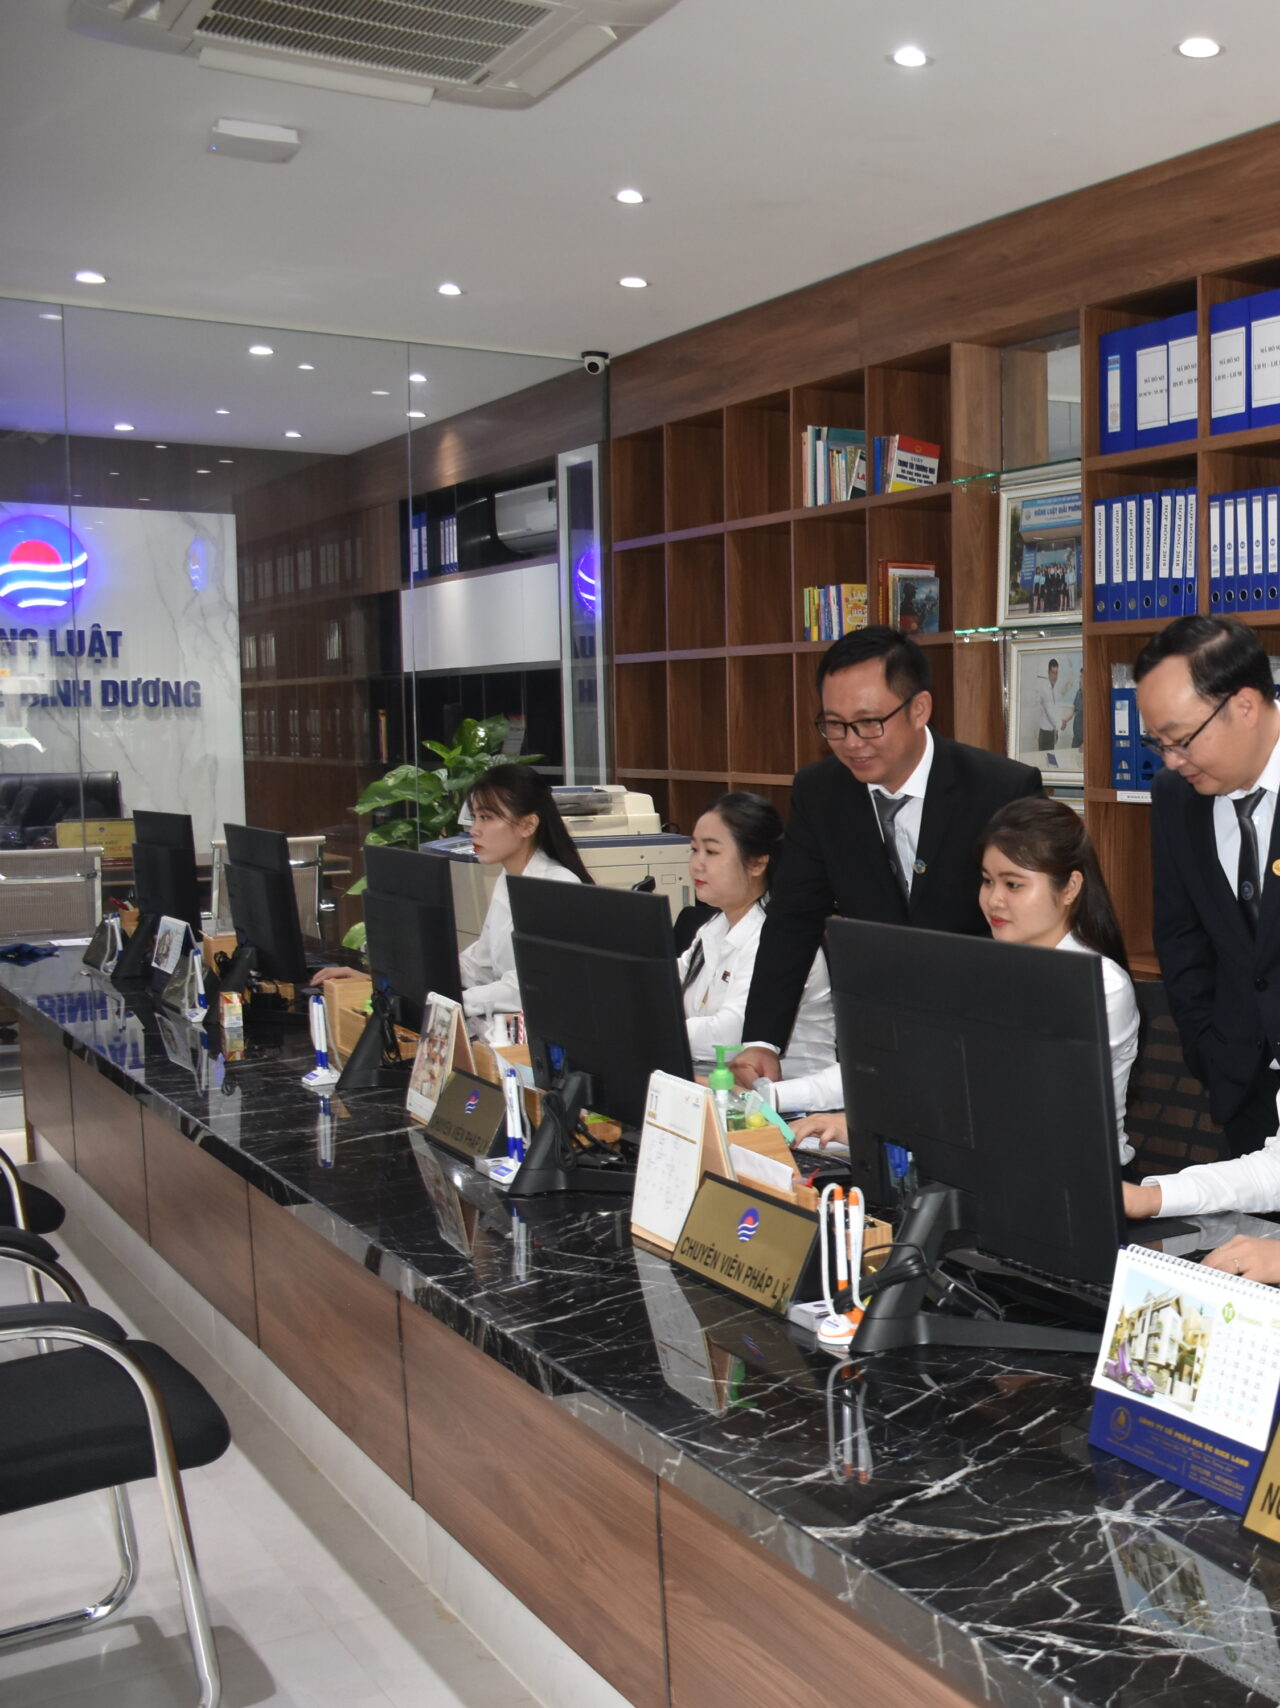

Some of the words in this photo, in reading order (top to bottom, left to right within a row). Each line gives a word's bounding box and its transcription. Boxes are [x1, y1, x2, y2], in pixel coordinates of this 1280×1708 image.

[49, 623, 122, 663] LUẬT
[101, 677, 202, 708] DƯƠNG
[680, 1236, 721, 1269] CHUYÊN
[721, 1253, 745, 1279] VIÊN
[745, 1263, 773, 1294] PHÁP
[772, 1278, 792, 1303] LÝ
